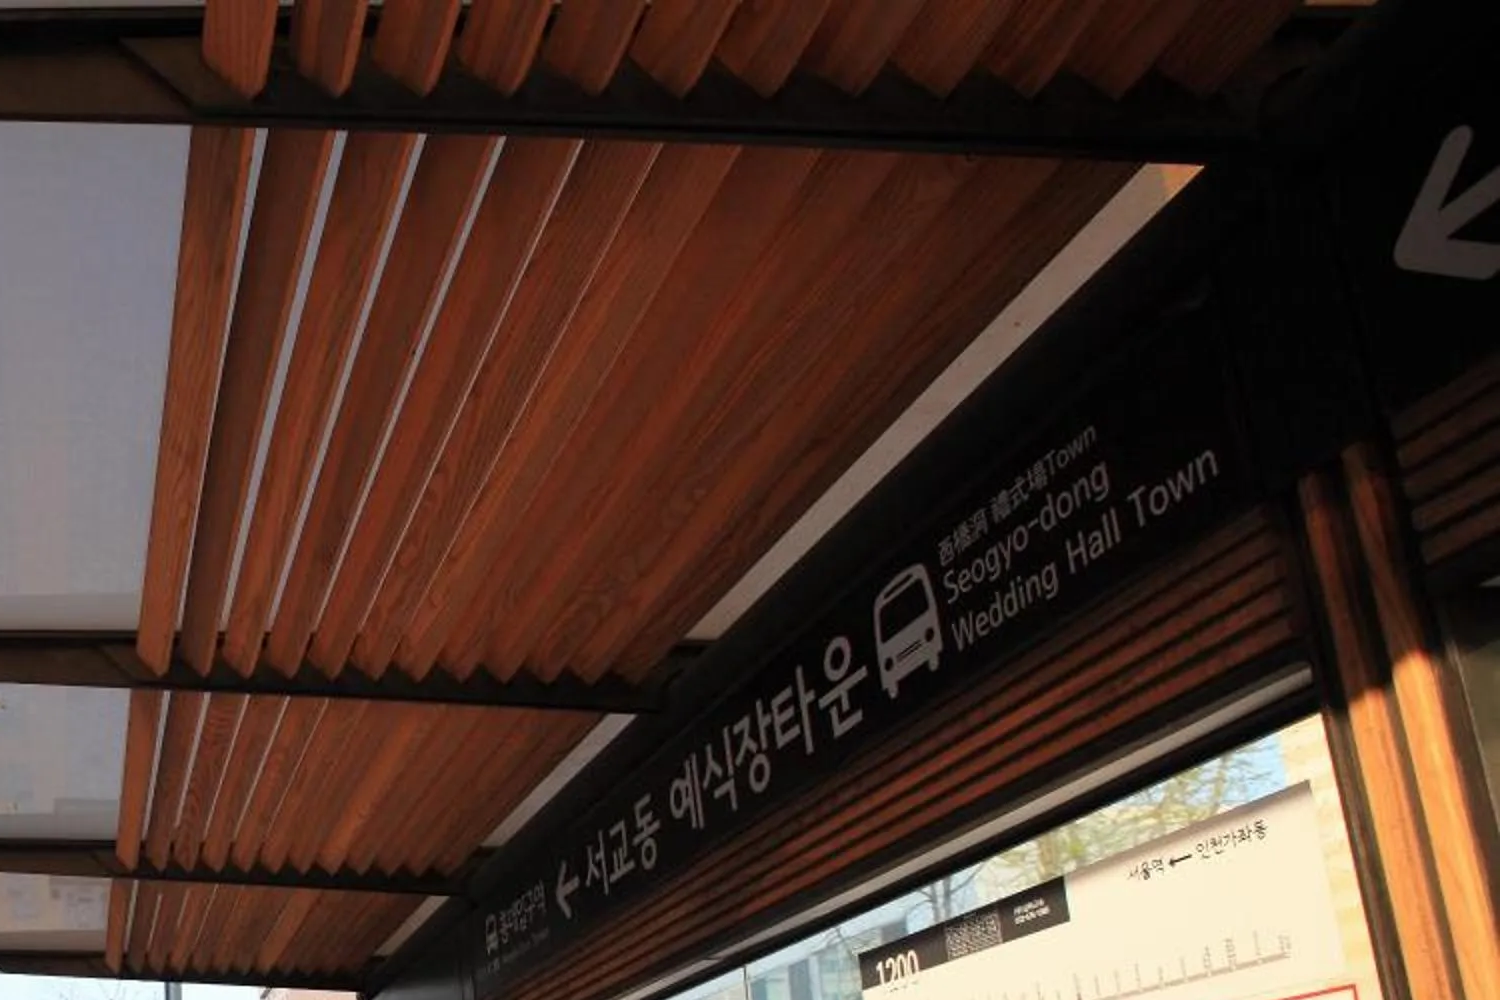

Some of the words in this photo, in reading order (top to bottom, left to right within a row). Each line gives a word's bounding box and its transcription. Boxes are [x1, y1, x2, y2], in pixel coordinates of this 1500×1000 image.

[941, 460, 1110, 605] Seogyo-dong
[951, 564, 1059, 653] Wedding
[1064, 506, 1122, 574] Hall
[1126, 449, 1220, 528] Town
[584, 792, 662, 896] 서교동
[669, 634, 869, 830] 예식장타운
[875, 949, 921, 992] 1200
